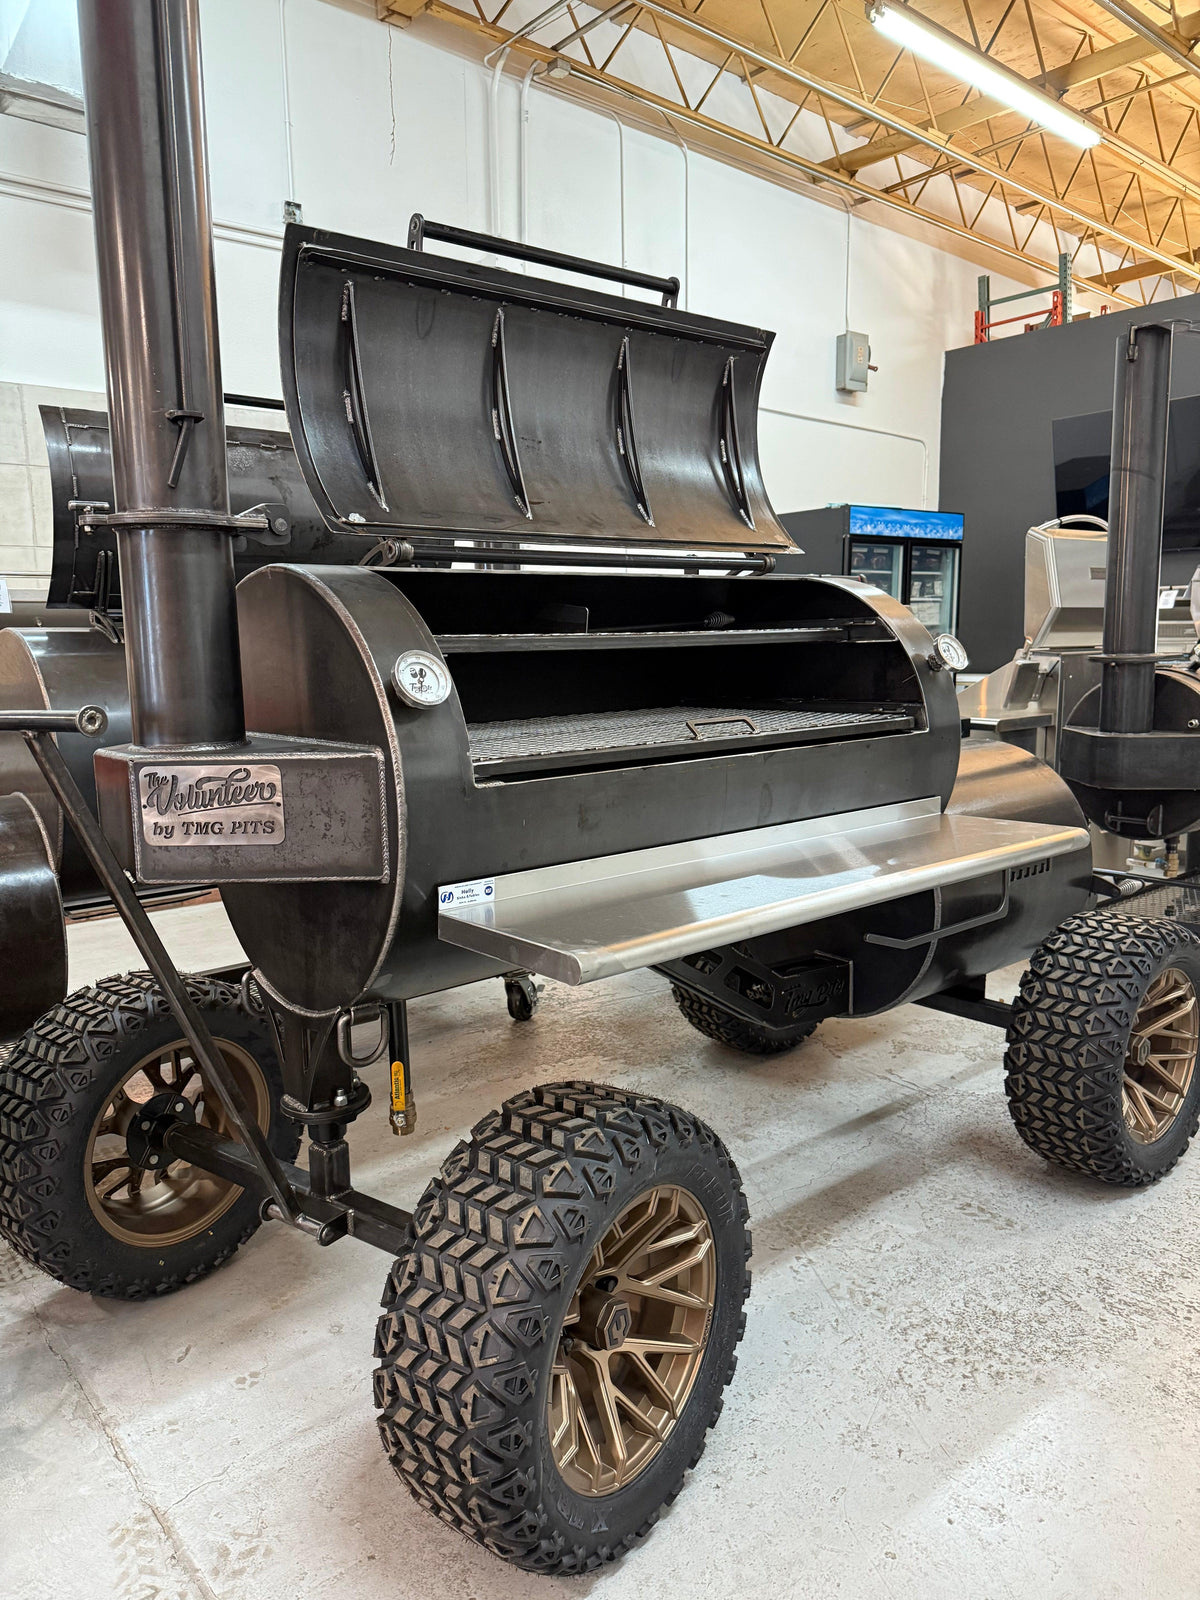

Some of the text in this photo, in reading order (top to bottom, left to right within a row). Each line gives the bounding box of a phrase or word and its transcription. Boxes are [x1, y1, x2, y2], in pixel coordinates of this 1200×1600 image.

[143, 772, 169, 789] The
[146, 767, 277, 815] Volunteer
[153, 820, 275, 839] by TMG PITS
